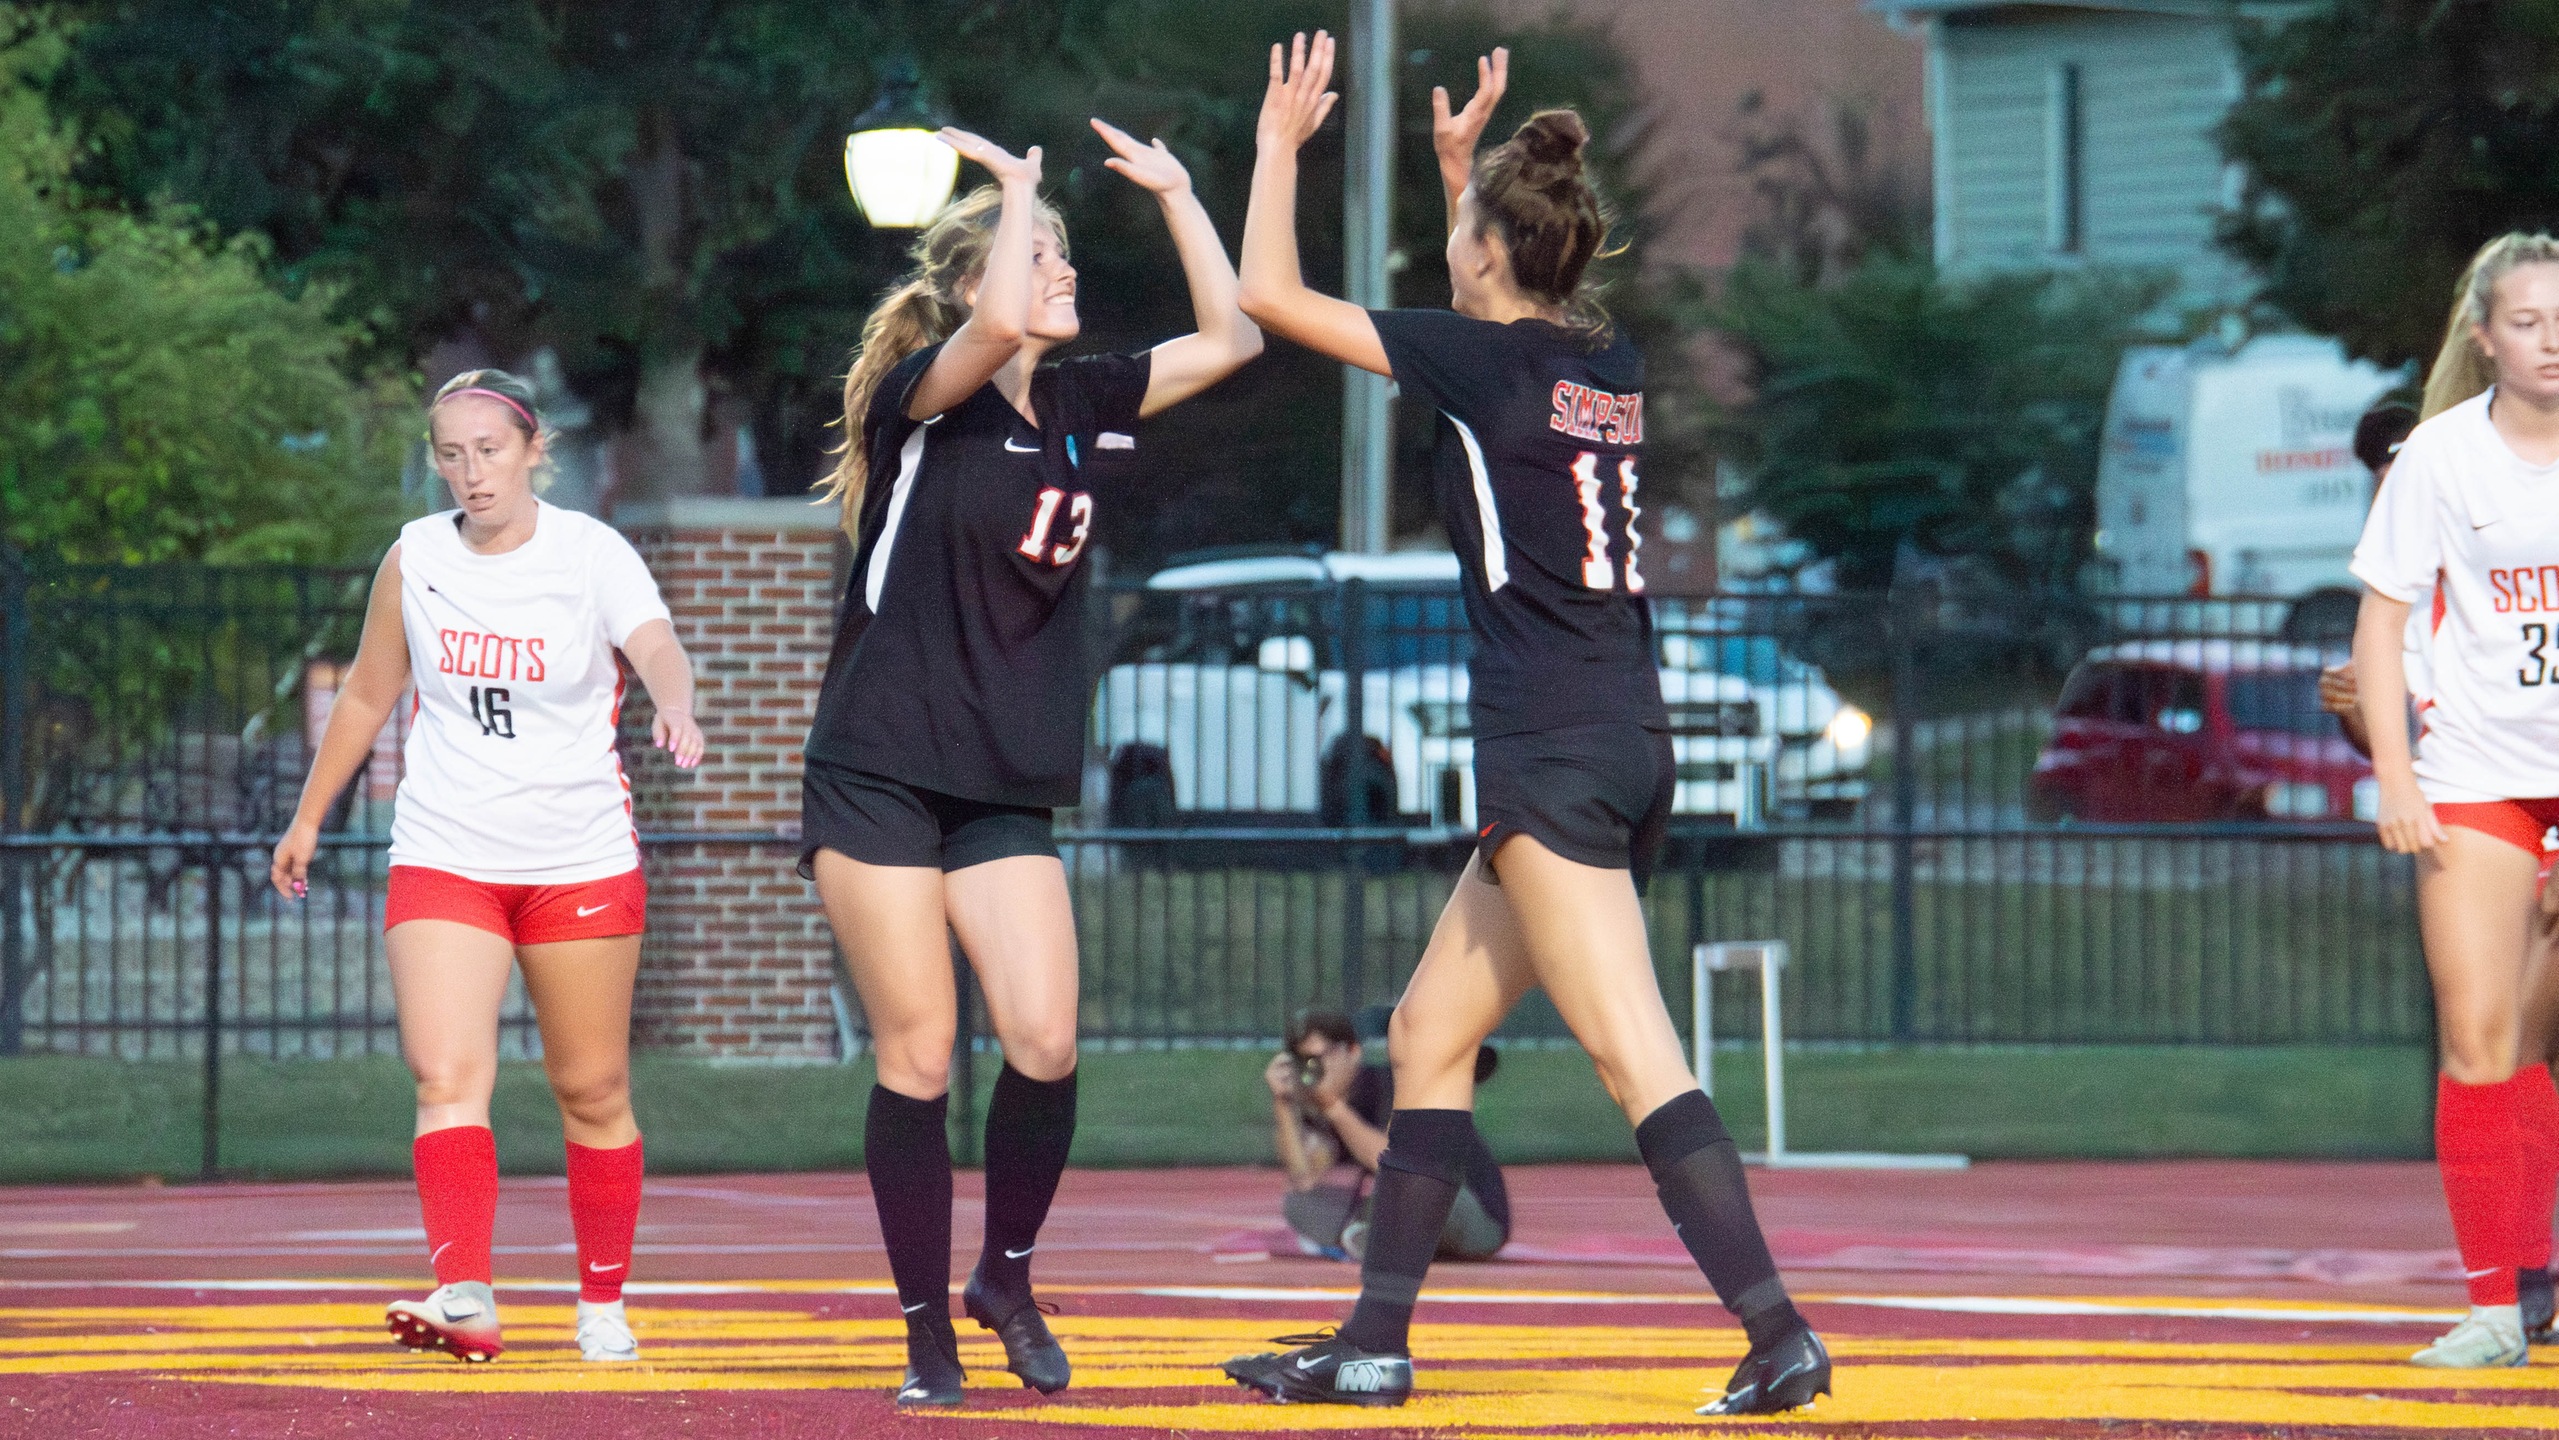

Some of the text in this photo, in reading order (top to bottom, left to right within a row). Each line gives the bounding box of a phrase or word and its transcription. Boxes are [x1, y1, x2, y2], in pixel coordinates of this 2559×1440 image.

[1016, 484, 1093, 567] 13
[439, 628, 545, 682] SCOTS
[2518, 623, 2559, 687] 3
[469, 686, 516, 739] 16
